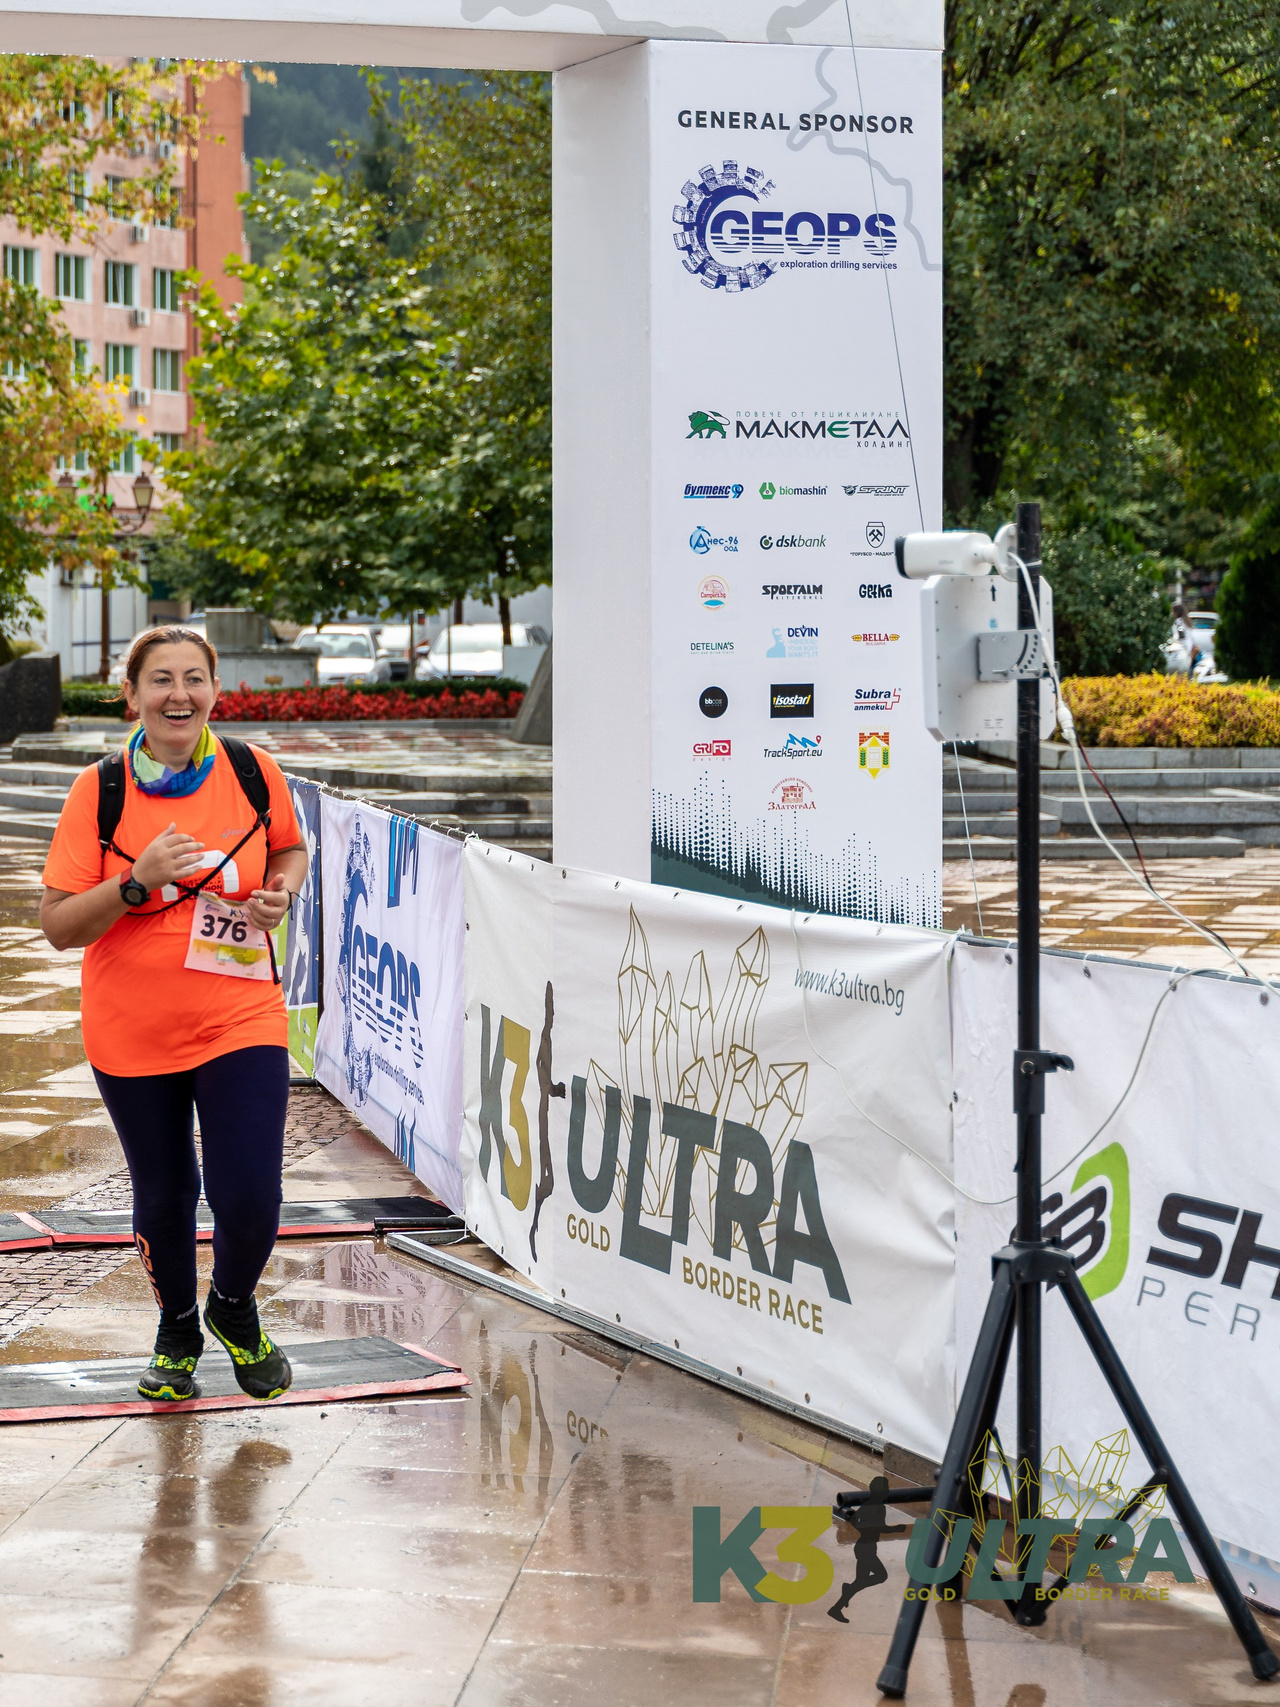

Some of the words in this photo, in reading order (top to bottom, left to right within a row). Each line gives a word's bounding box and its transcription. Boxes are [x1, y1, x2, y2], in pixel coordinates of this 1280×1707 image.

[677, 109, 790, 131] GENERAL
[799, 113, 914, 134] SPONSOR
[710, 210, 897, 256] GEOPS
[780, 260, 828, 269] exploration
[830, 260, 860, 271] drilling
[862, 261, 898, 270] services
[736, 418, 910, 440] МАКМЕТАЛ
[857, 440, 910, 448] ХОЛДИНГ
[776, 535, 827, 547] dskbank
[787, 627, 819, 638] DEVIN
[862, 633, 890, 642] BELLA
[854, 688, 891, 699] Subra
[763, 748, 823, 759] TrackSport.eu
[200, 913, 248, 943] 376
[794, 967, 905, 1016] www.k3ultra.bg
[477, 1003, 532, 1212] K3
[567, 1075, 852, 1305] ULTRA
[567, 1213, 610, 1253] GOLD
[682, 1255, 761, 1312] BORDER
[768, 1289, 824, 1336] RACE
